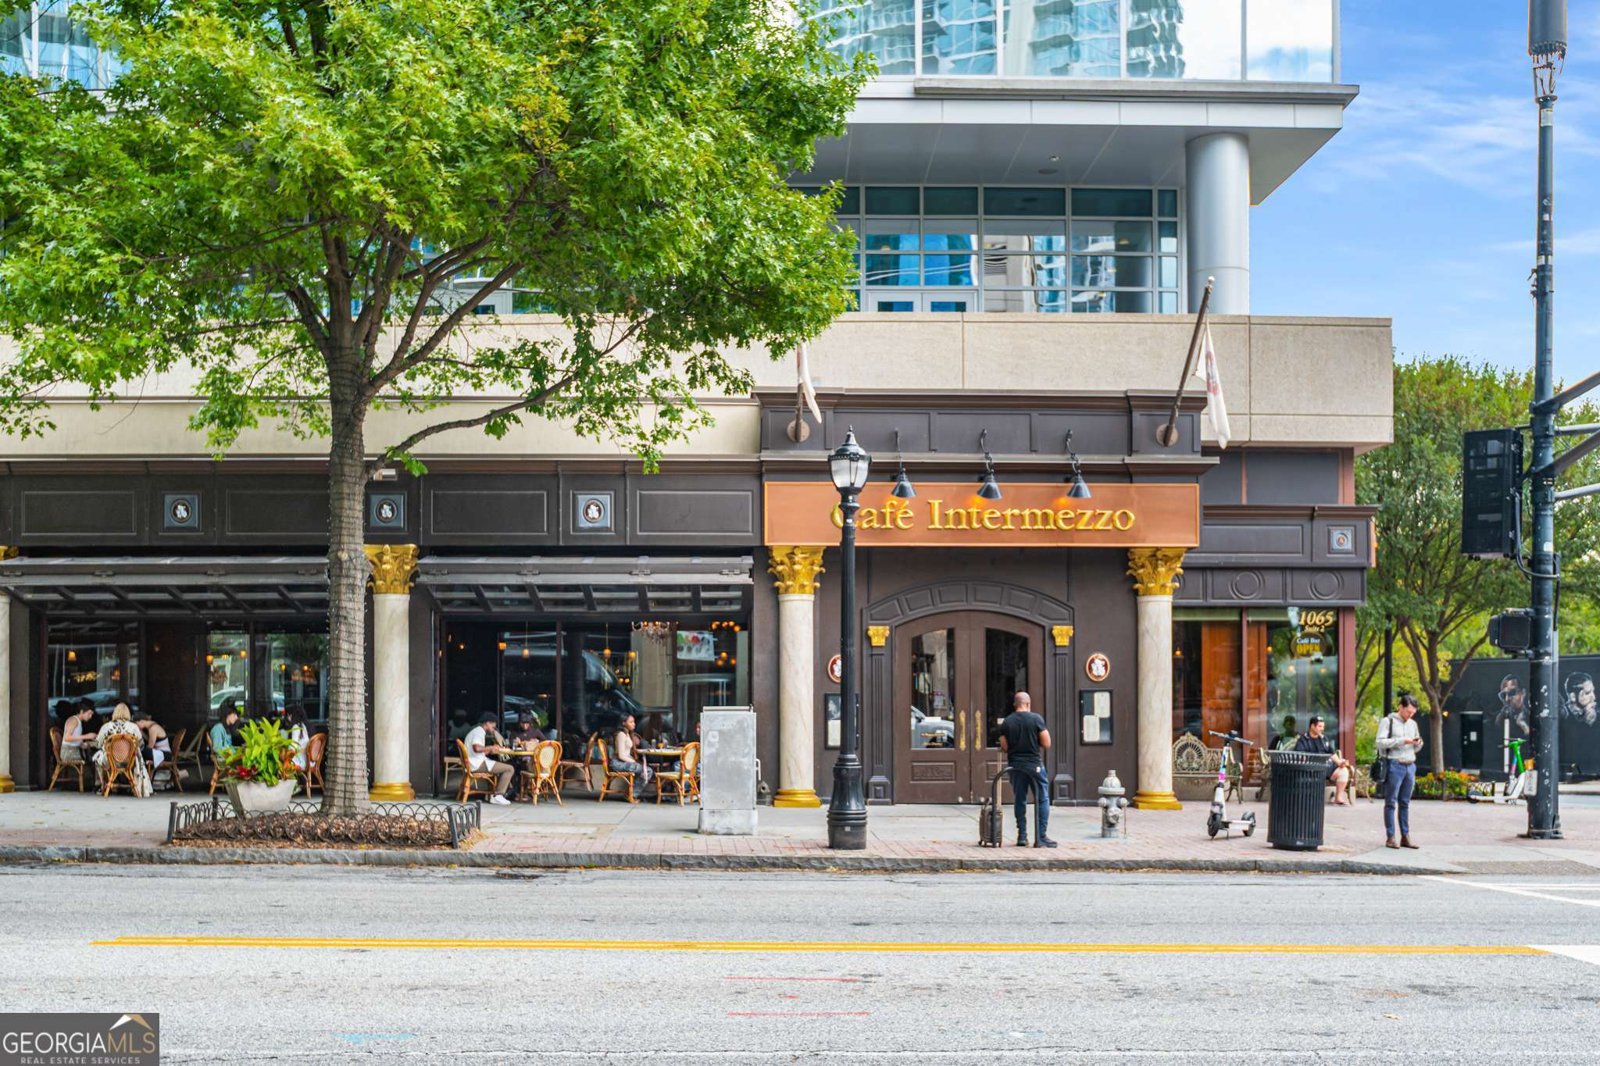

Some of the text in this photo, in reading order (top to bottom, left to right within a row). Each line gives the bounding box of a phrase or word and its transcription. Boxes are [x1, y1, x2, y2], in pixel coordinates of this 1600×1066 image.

[927, 499, 1136, 531] Intermezzo
[1298, 610, 1334, 625] 1065
[1296, 643, 1321, 655] OPEN
